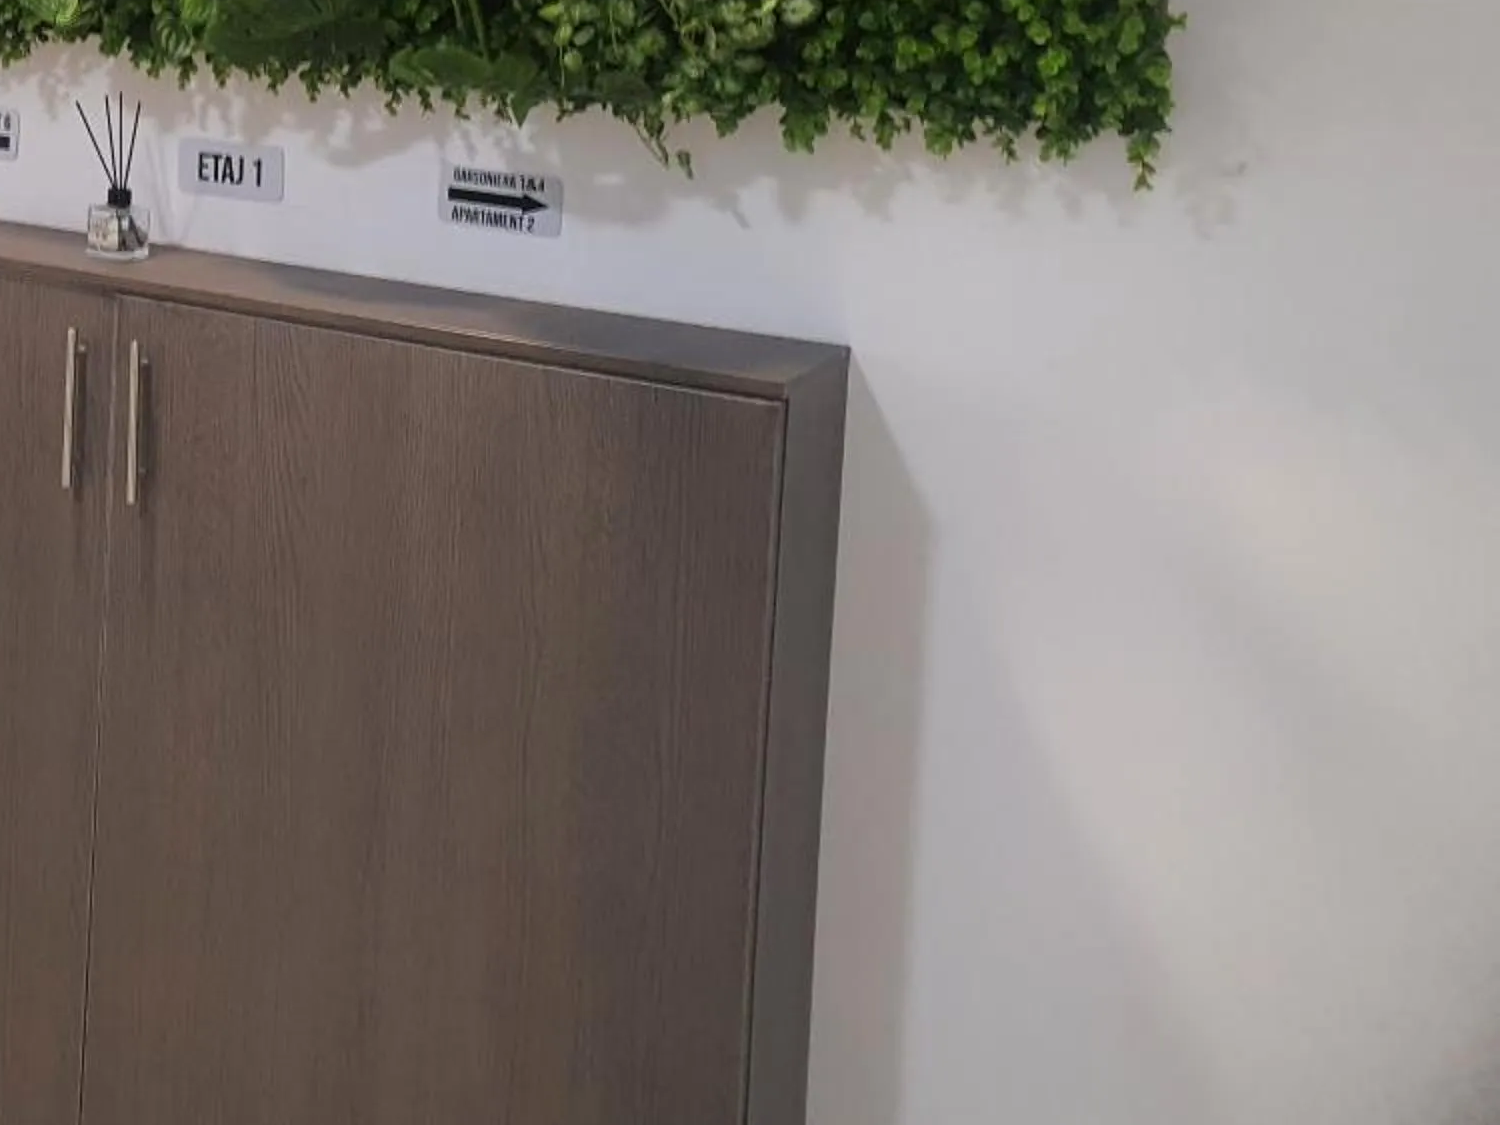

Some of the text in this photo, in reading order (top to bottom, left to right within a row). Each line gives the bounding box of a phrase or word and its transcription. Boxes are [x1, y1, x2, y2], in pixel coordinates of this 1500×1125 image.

[198, 152, 263, 188] ETAJ 1
[451, 205, 536, 234] APARTAMENT 2
